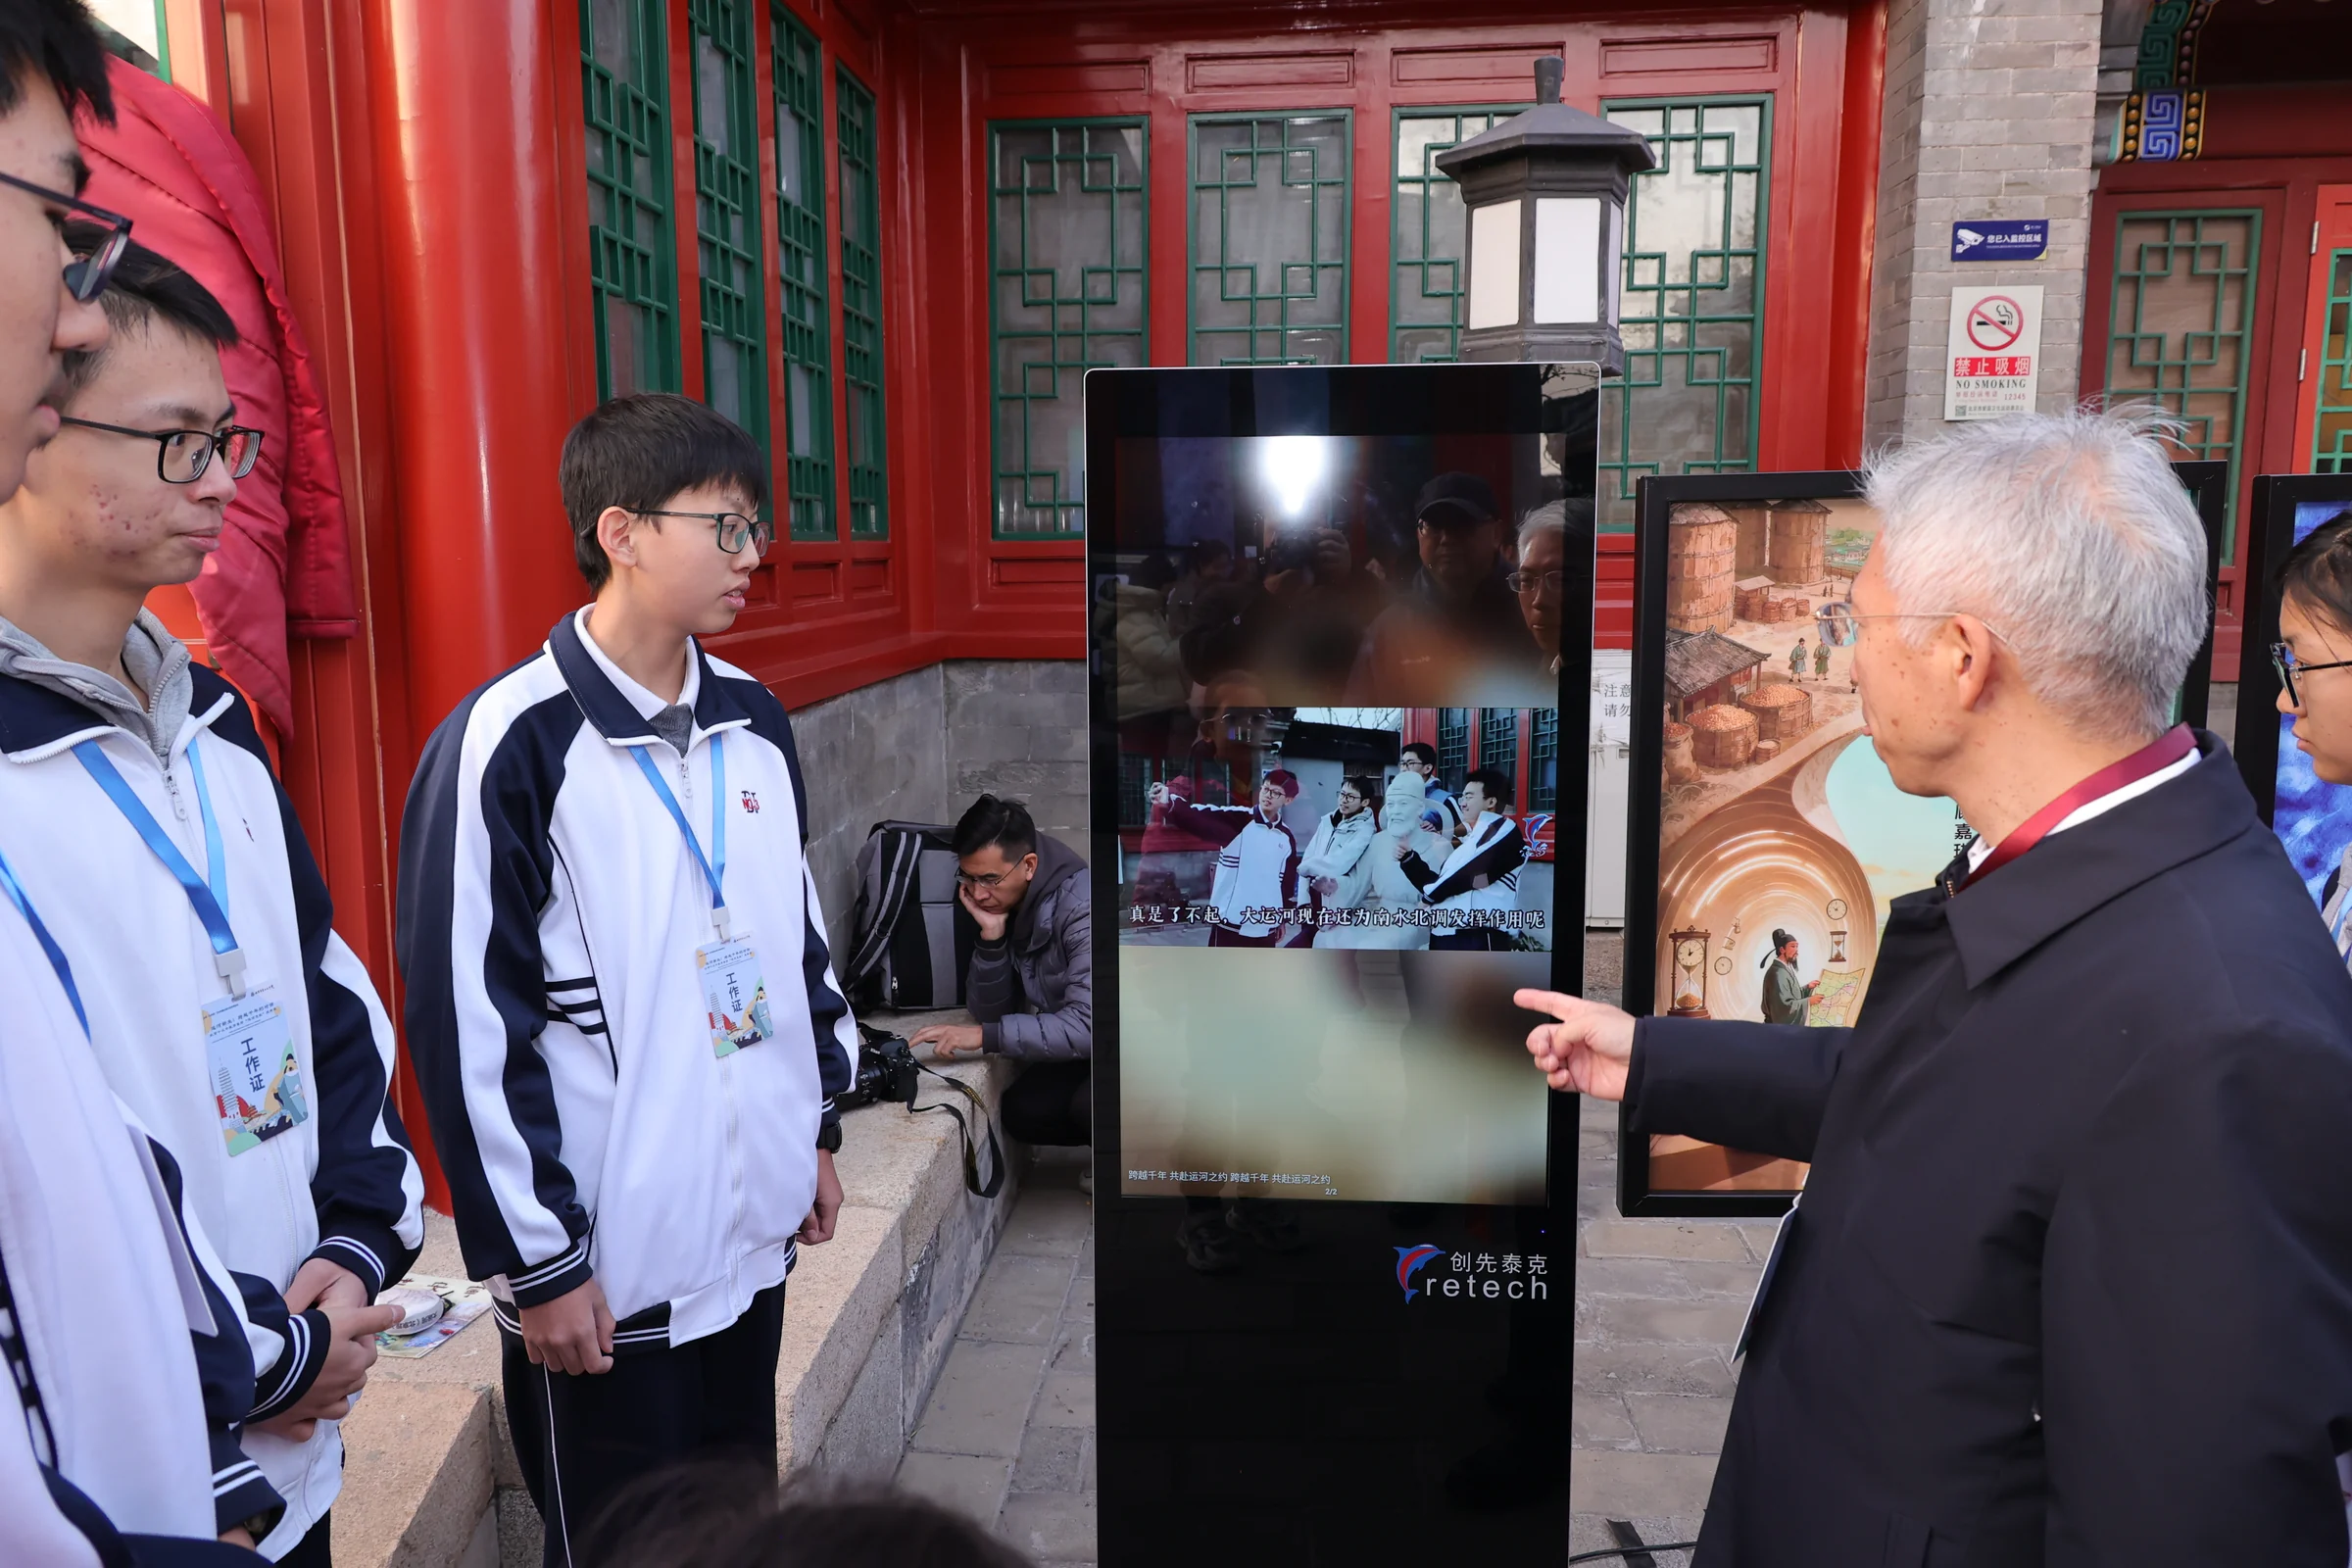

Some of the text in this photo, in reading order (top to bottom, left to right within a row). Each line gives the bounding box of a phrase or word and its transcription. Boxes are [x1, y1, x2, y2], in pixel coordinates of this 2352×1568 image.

[1986, 233, 2042, 244] 您已入监控区域
[1955, 357, 2030, 376] 禁止吸烟
[1956, 378, 2027, 389] NO SMOKING
[1604, 684, 1631, 698] 注意
[1129, 905, 1545, 929] 真是了不起，大运河现在还为南水北调发挥作用呢
[726, 972, 743, 1013] 工作证
[241, 1037, 266, 1093] 工作证
[1128, 1169, 1331, 1185] 跨越千年 共赴运河之约 跨越千年 共赴运河之约
[1449, 1250, 1547, 1275] 创先泰克
[1426, 1274, 1547, 1300] retech
